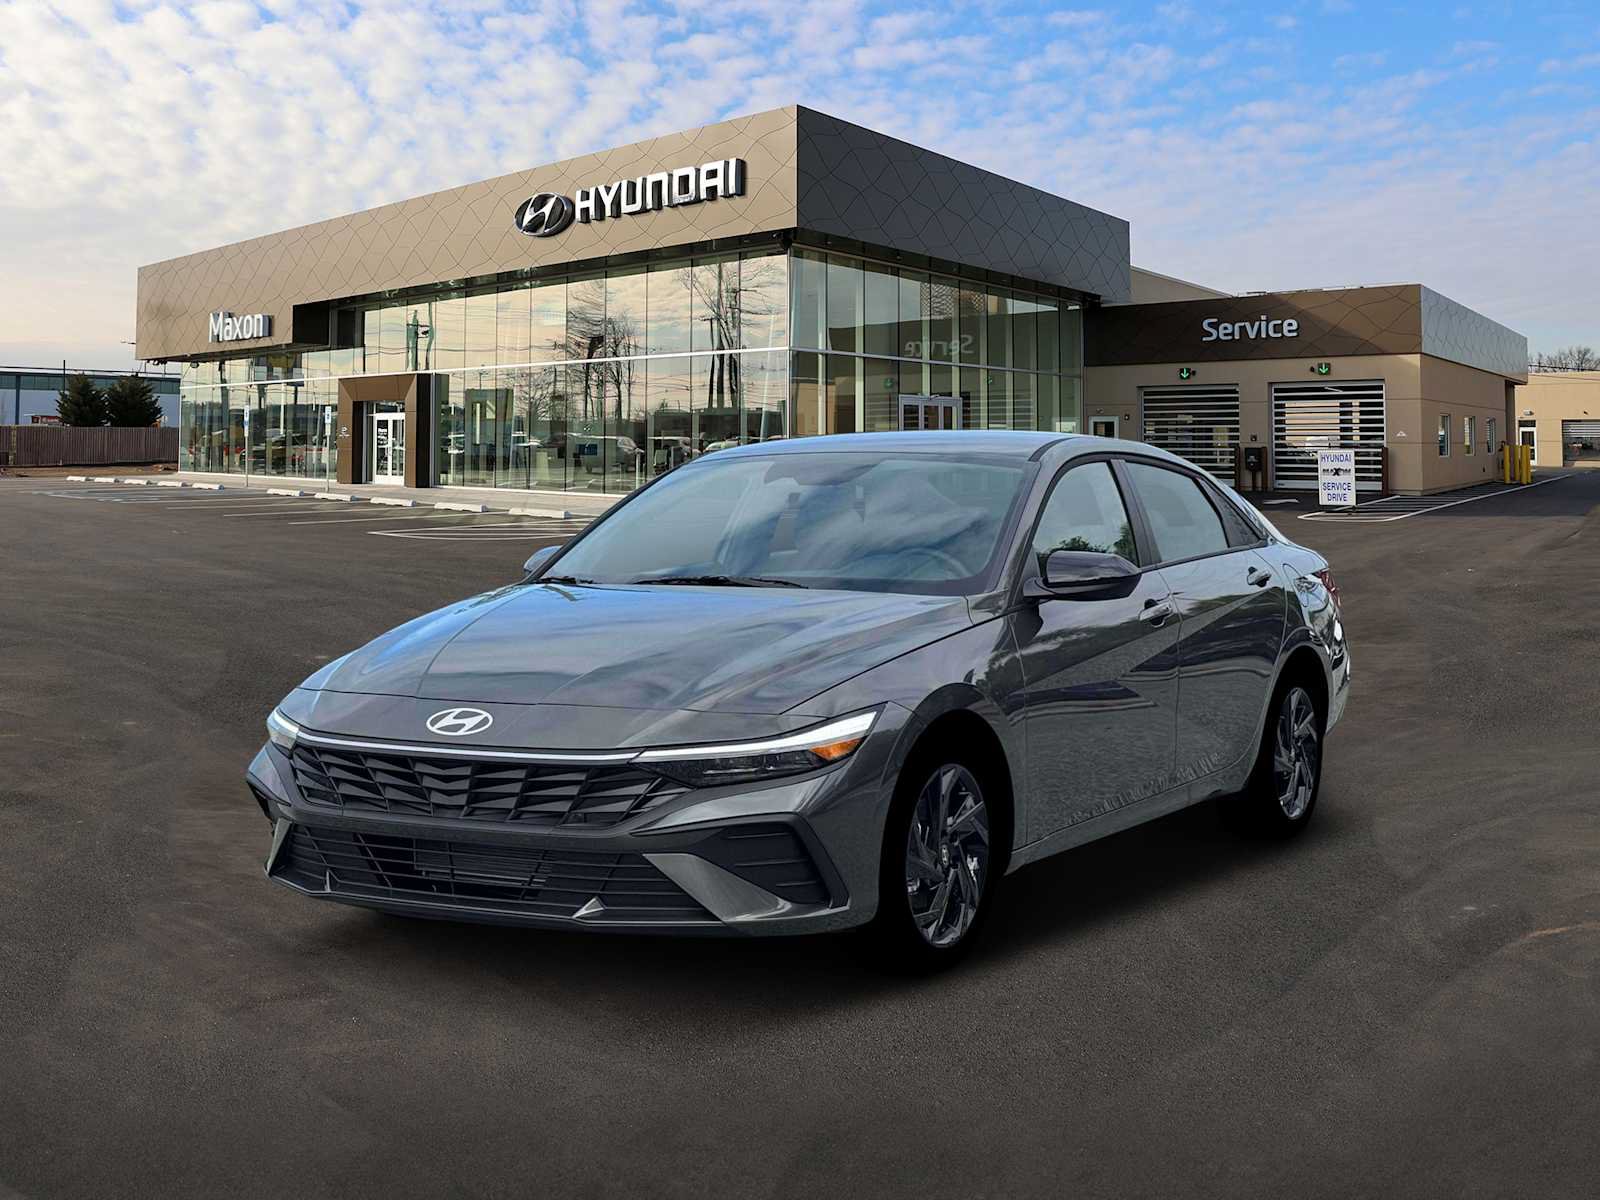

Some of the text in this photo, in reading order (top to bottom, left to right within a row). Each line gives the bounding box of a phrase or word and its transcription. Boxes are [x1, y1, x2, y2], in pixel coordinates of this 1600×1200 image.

[575, 157, 741, 223] HYUNDAI
[208, 311, 269, 343] Maxon
[1202, 314, 1298, 341] Service
[1321, 454, 1352, 462] HYUNDAI
[1322, 482, 1352, 491] SERVICE
[1327, 493, 1348, 502] DRIVE
